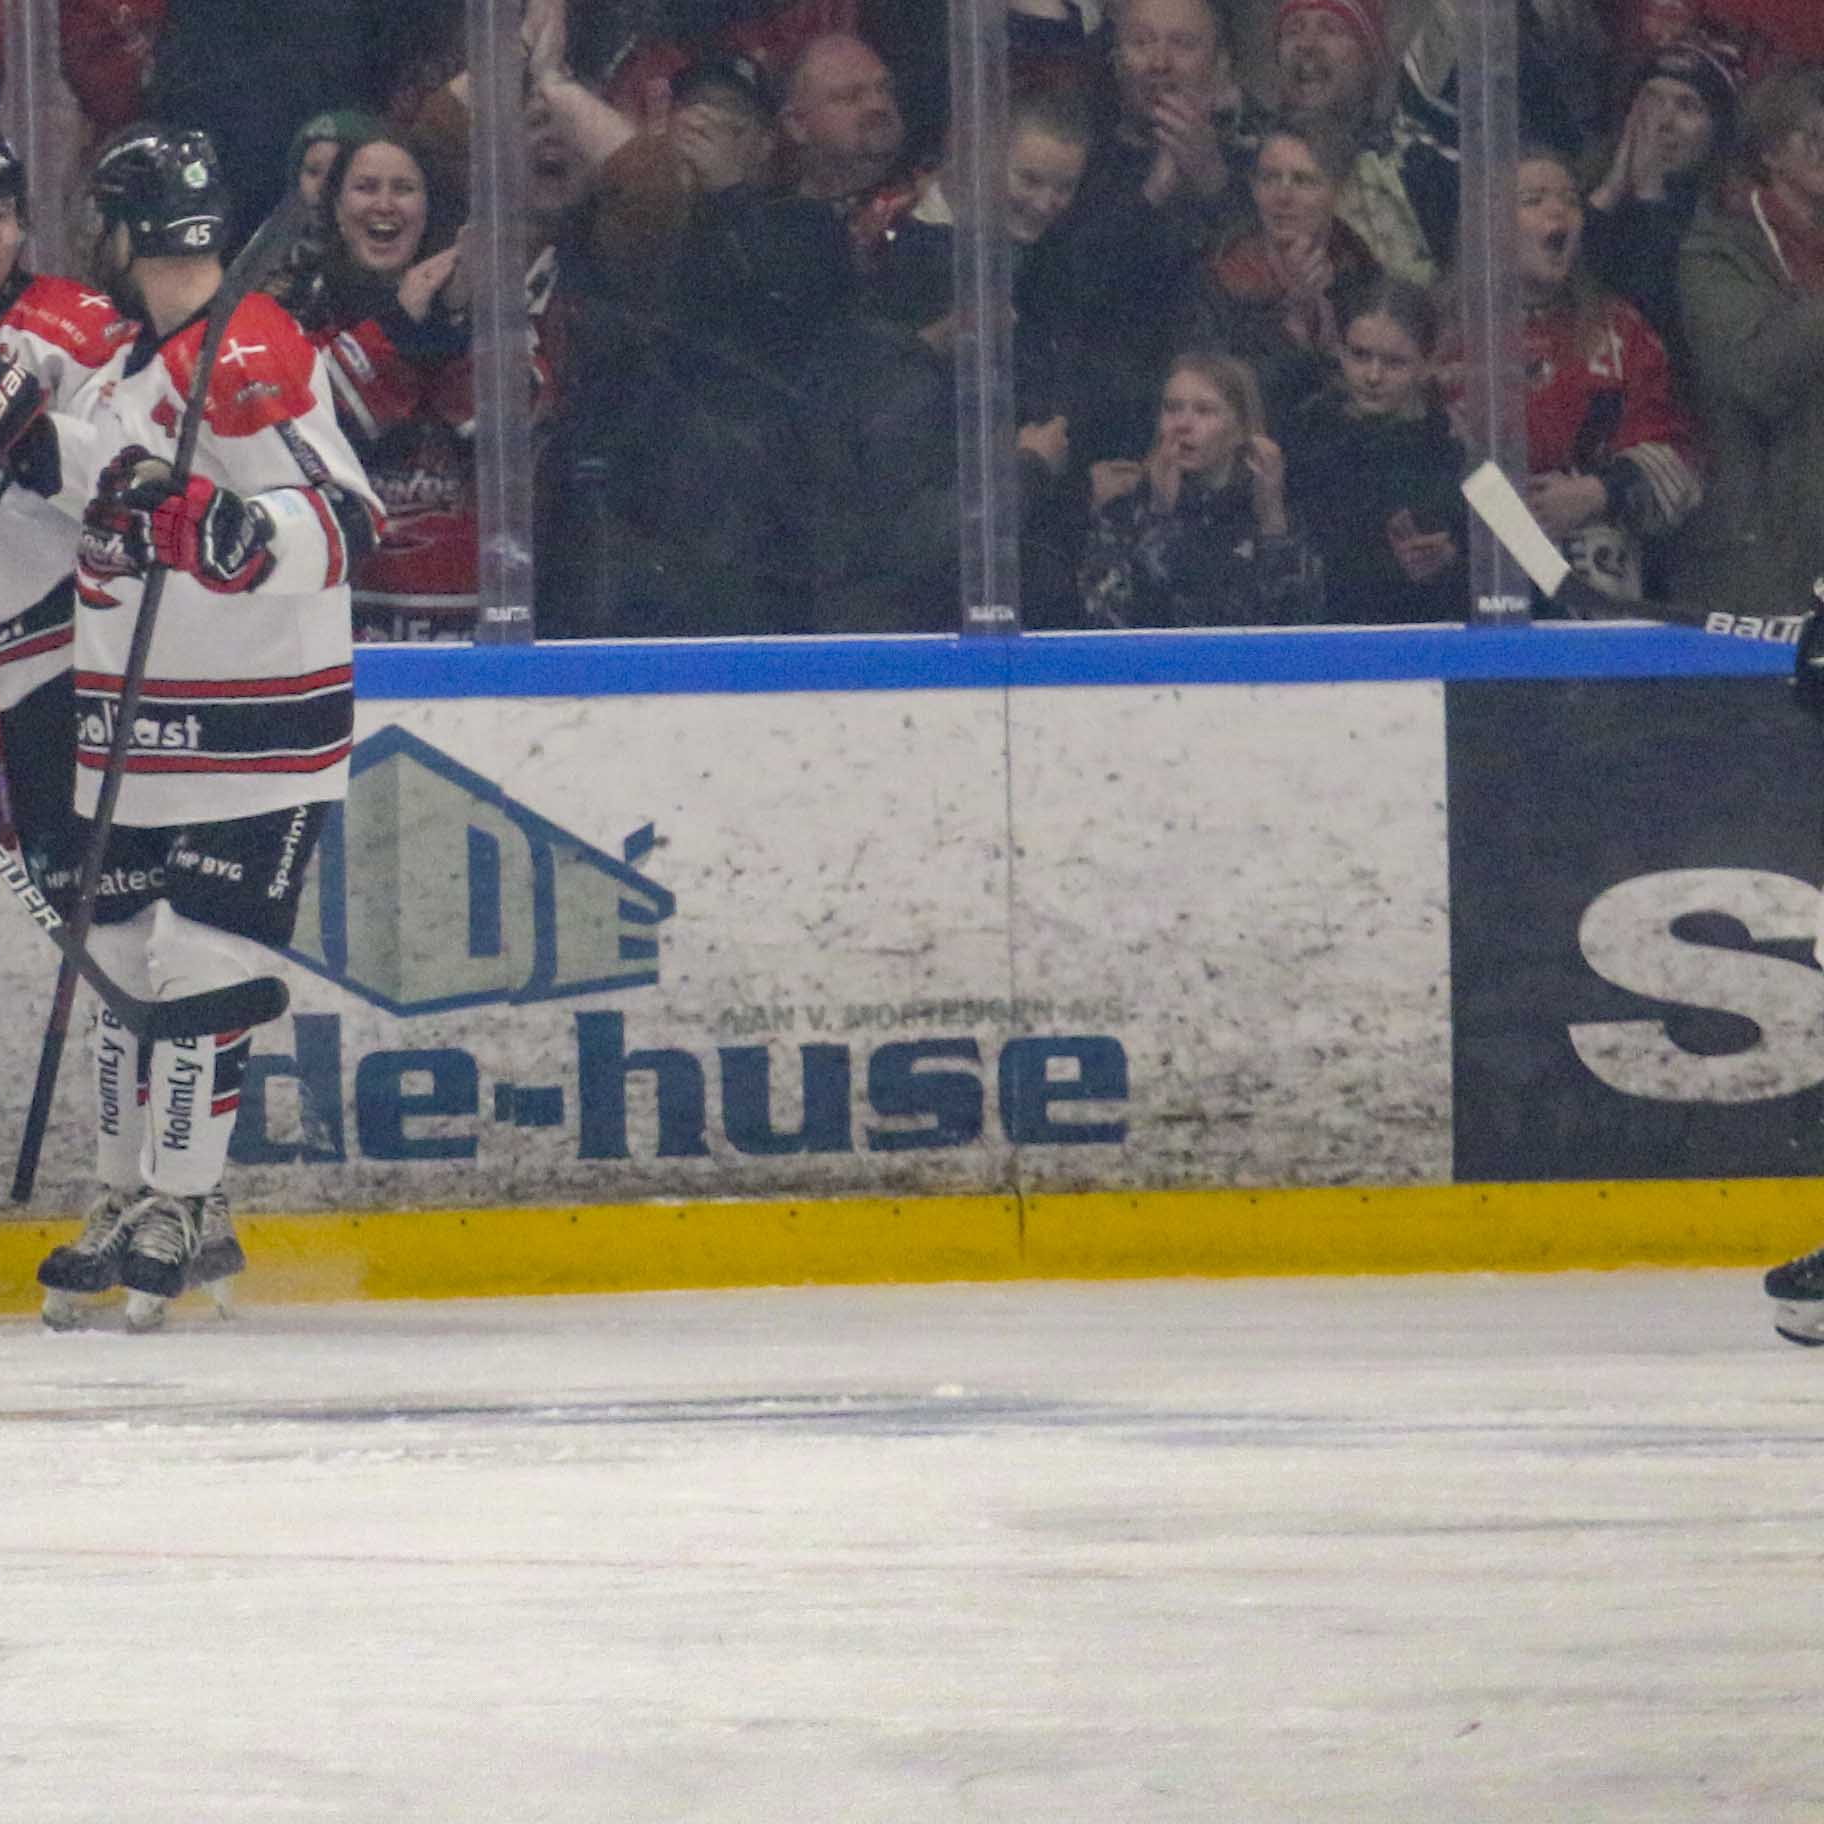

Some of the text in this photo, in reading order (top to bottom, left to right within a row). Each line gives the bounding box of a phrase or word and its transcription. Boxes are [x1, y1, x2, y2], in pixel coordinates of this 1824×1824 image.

[183, 224, 212, 247] 45
[1704, 609, 1804, 646] BAU
[228, 1010, 1130, 1164] de-huse
